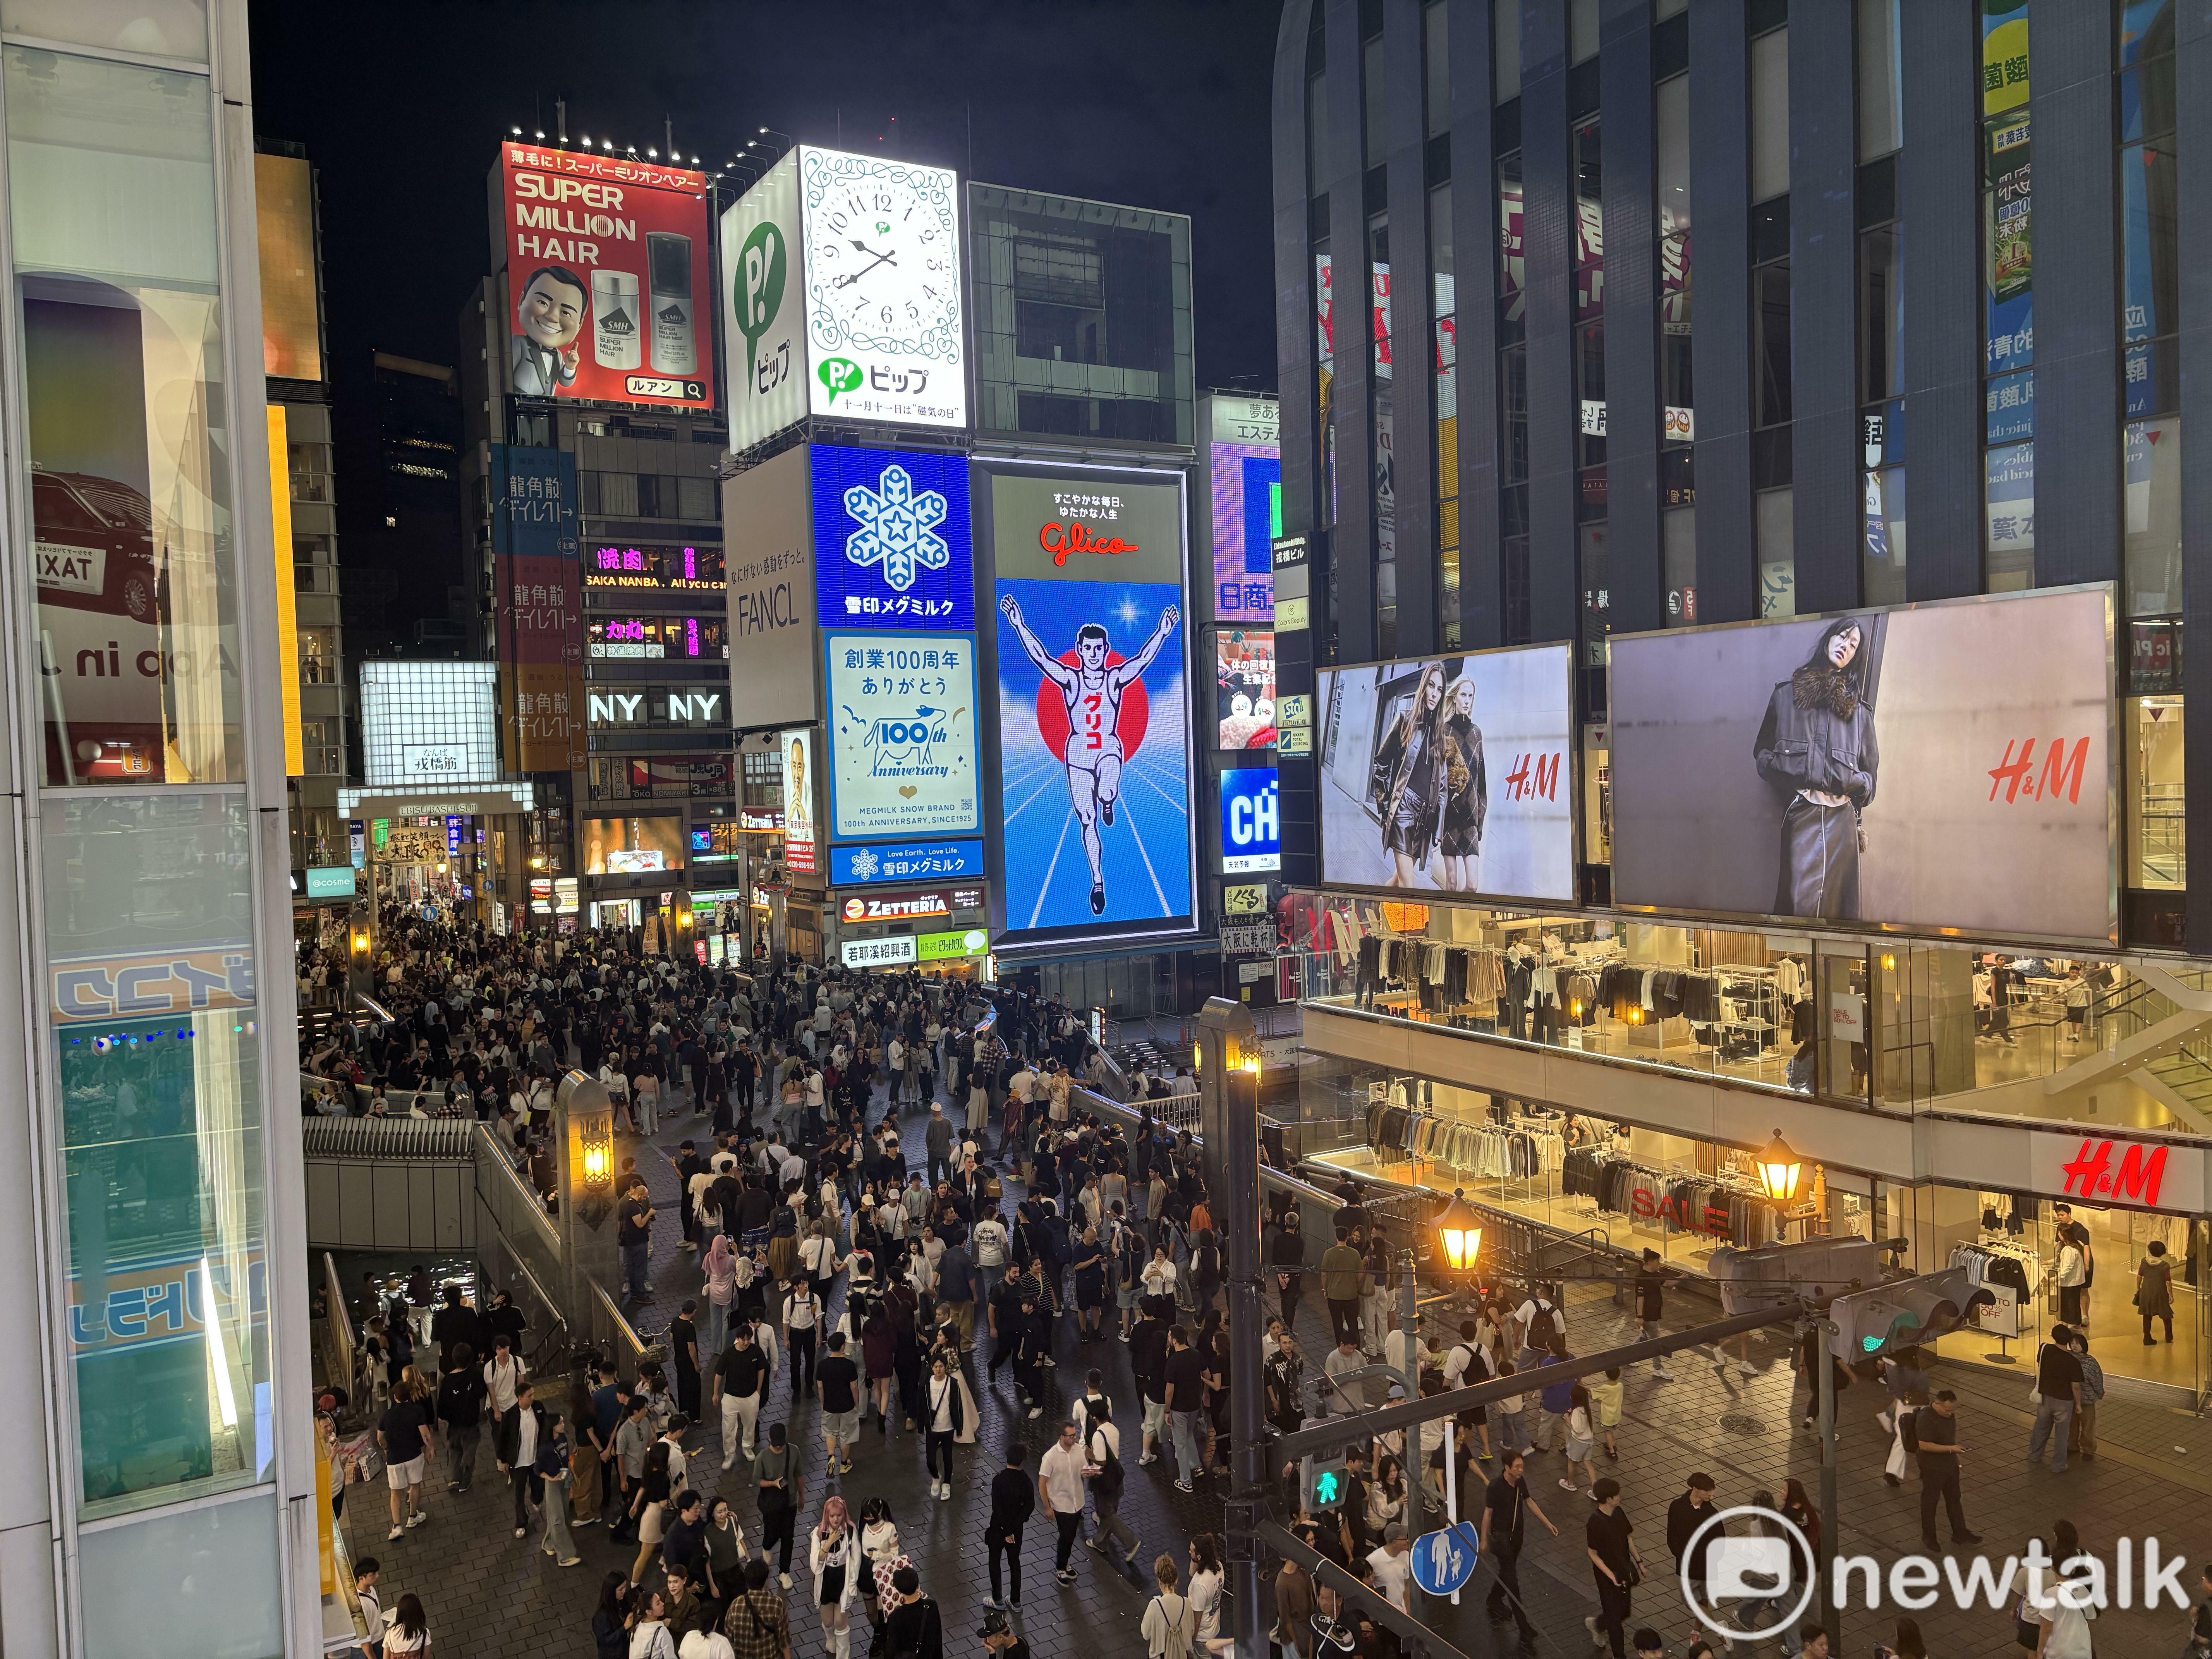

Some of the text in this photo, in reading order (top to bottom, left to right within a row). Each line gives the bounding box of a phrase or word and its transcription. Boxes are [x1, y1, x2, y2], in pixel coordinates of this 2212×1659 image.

[511, 149, 699, 187] 薄毛に！スーパーミリオンヘアー
[515, 173, 624, 210] SUPER
[848, 196, 866, 215] 11
[872, 194, 891, 212] 12
[516, 204, 635, 241] MILLION
[904, 208, 912, 221] 1
[828, 213, 847, 235] 10
[918, 230, 934, 244] 2
[518, 234, 598, 264] HAIR
[824, 245, 839, 258] 9
[927, 259, 942, 271] 3
[833, 275, 848, 289] 8
[923, 285, 937, 299] 4
[855, 295, 871, 310] 7
[905, 300, 918, 319] 5
[881, 306, 892, 323] 6
[608, 321, 628, 330] SMH
[599, 337, 621, 345] SUPER
[599, 343, 623, 352] MILLION
[600, 349, 615, 357] HAIR
[758, 339, 790, 395] ピップ
[632, 381, 672, 392] ルアン
[871, 365, 929, 394] ピップ
[509, 476, 562, 499] 龍角散
[1053, 493, 1125, 508] すこやかな毎日、
[1059, 508, 1118, 520] ゆたかな人生
[1041, 522, 1139, 567] Glico
[597, 548, 642, 570] 焼肉
[1276, 548, 1304, 563] 戎橋ビル
[731, 548, 804, 584] なにげない感動をずっと。
[671, 579, 686, 588] All
[514, 584, 567, 606] 龍角散
[1221, 583, 1274, 610] 日商
[738, 582, 799, 636] FANCL
[845, 595, 953, 616] 雪印メグミルク
[606, 620, 644, 640] 力丸
[845, 649, 960, 670] 創業100周年
[862, 677, 945, 695] ありがとう
[518, 692, 570, 715] 龍角散
[591, 694, 720, 721] NY NY
[1084, 692, 1103, 749] グリコ
[424, 749, 448, 757] なんば
[415, 757, 457, 771] 戎橋筋
[690, 762, 723, 777] 風月
[867, 765, 948, 778] Anniversary
[1988, 737, 2090, 805] H&M
[615, 759, 623, 797] お好み焼き
[1505, 752, 1560, 802] H&M
[859, 806, 896, 814] MEGMILK
[748, 815, 773, 828] ZETTERIA
[883, 857, 964, 876] 雪印メグミルク
[313, 879, 350, 887] @cosme
[868, 899, 947, 916] ZETTERIA
[1233, 889, 1259, 909] くくる
[939, 938, 963, 951] ピタットハウス
[1224, 931, 1268, 949] 大阪に乾杯
[2062, 1139, 2168, 1207] H&M
[1631, 1188, 1730, 1239] SALE
[1996, 1298, 2010, 1307] TO
[1981, 1309, 2001, 1318] OFF
